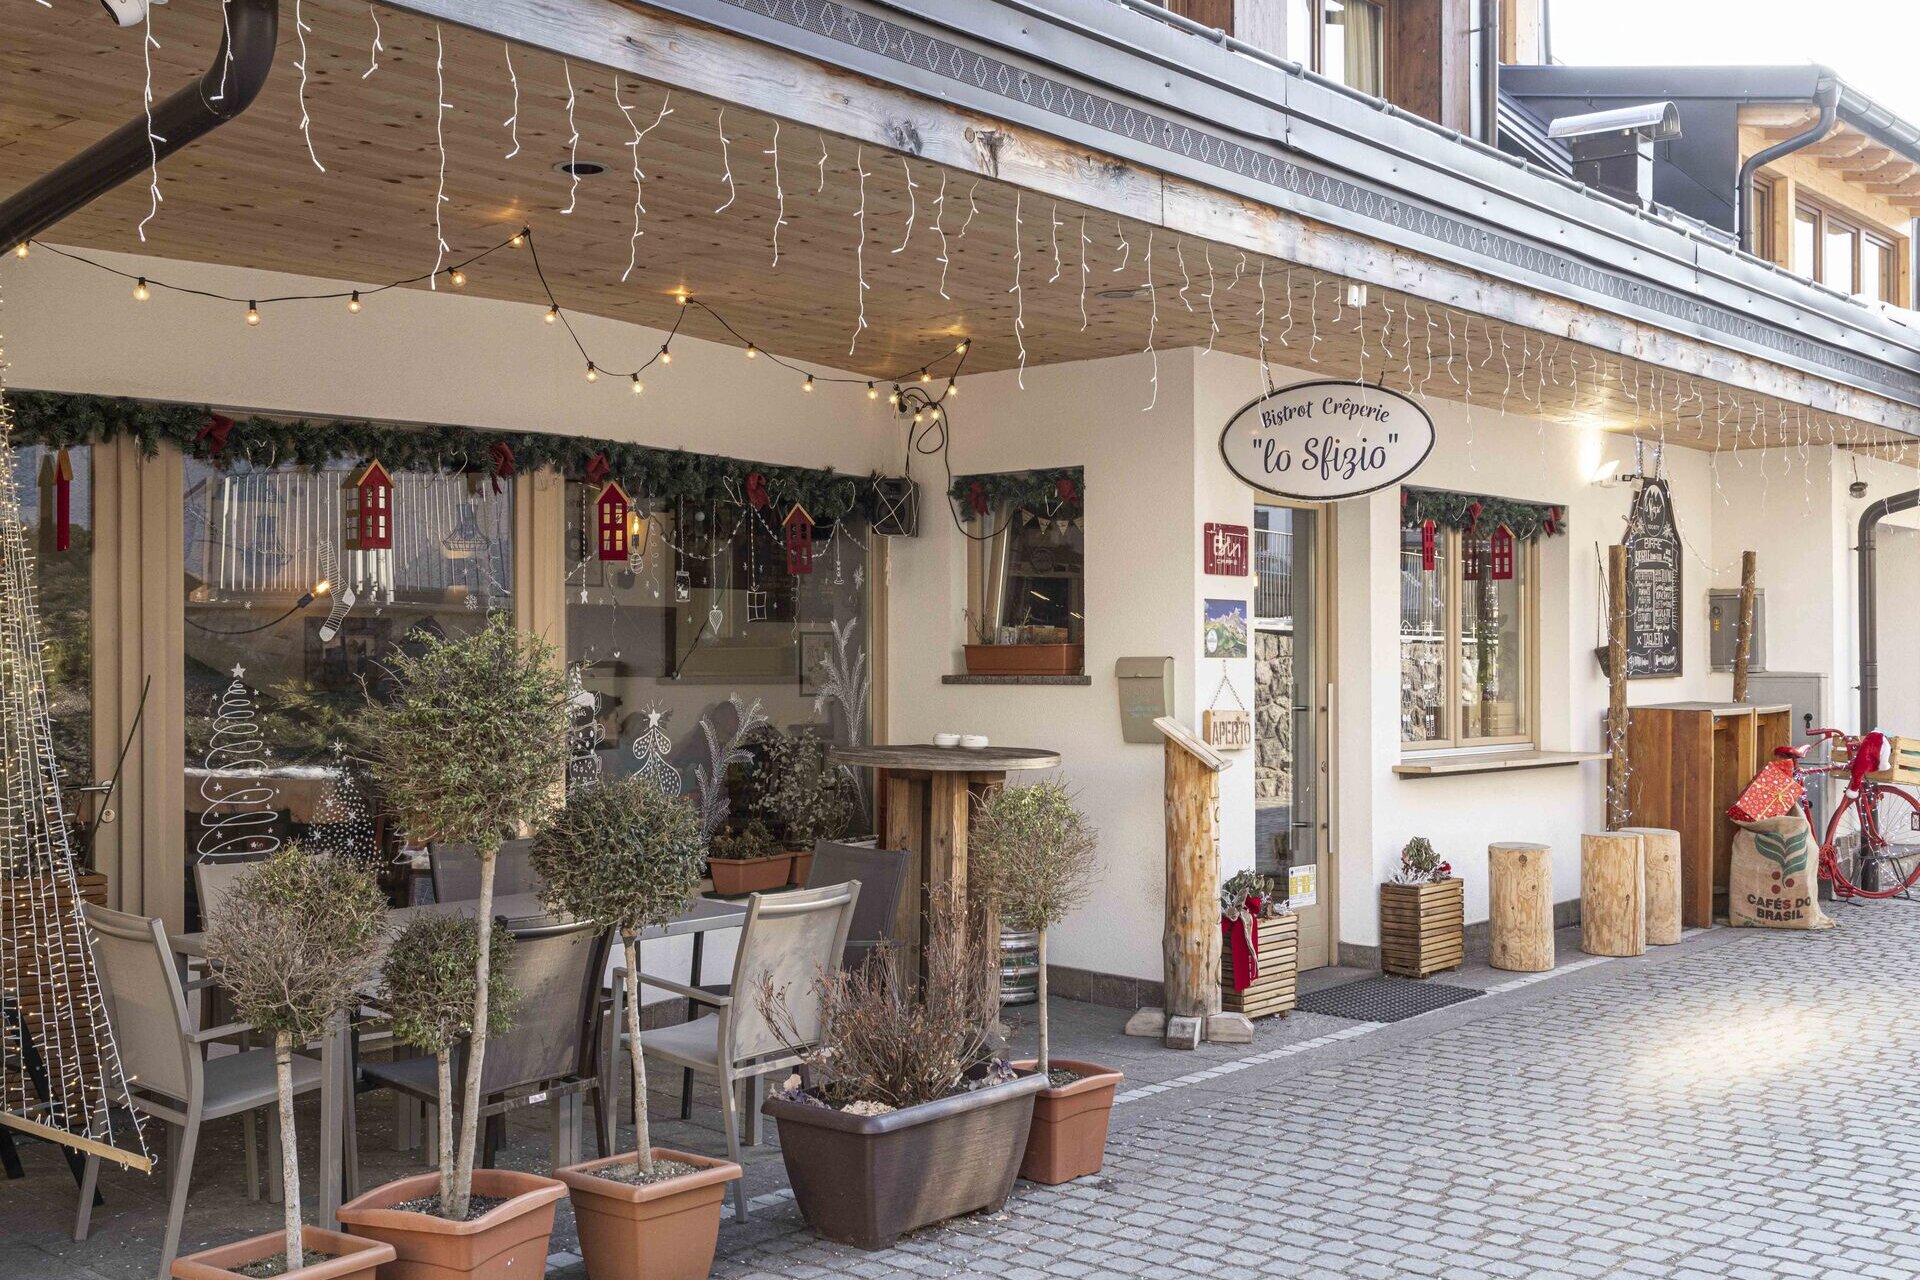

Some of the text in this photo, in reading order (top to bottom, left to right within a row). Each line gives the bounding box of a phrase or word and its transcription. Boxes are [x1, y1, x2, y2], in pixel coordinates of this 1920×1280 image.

[1262, 397, 1390, 428] Bistrot Crêperie
[1212, 720, 1251, 745] APERTO
[1747, 894, 1811, 910] CAFÉS DO
[1756, 908, 1804, 921] BRASIL
